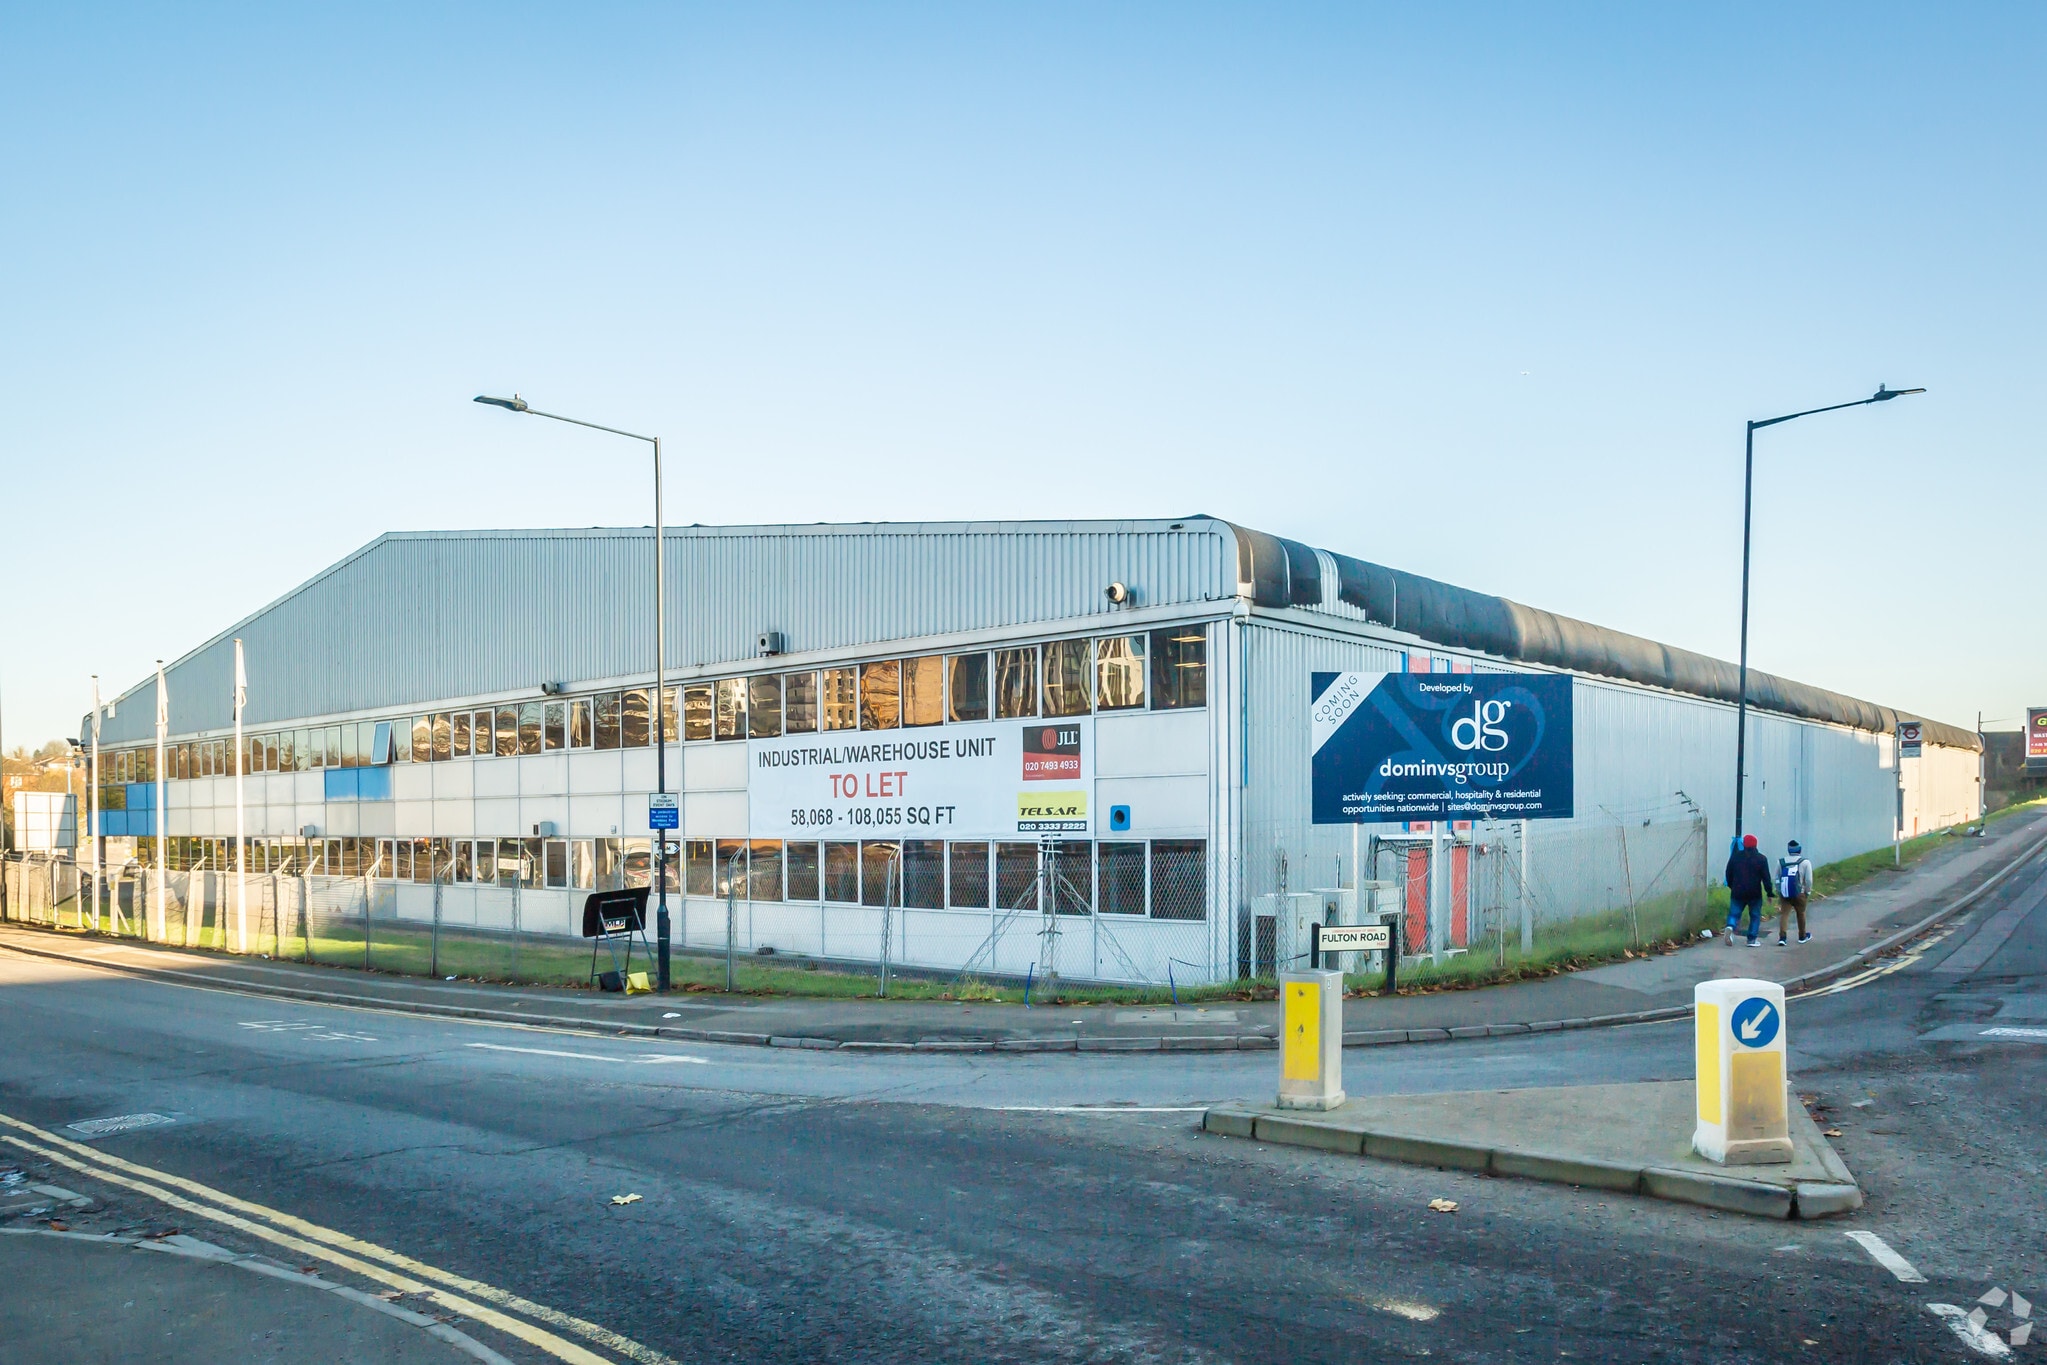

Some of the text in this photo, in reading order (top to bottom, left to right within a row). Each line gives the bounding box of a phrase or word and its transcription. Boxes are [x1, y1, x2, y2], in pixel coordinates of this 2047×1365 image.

[1419, 683, 1474, 694] Developed by
[1315, 675, 1358, 722] COMING
[1328, 690, 1359, 724] SOON
[1451, 699, 1512, 751] dg
[1057, 731, 1078, 746] JLL
[758, 737, 997, 768] INDUSTRIAL/WAREHOUSE UNIT
[1025, 760, 1079, 771] 020 7493 4933
[1379, 758, 1510, 785] dominvsgroup
[829, 771, 908, 799] TO LET
[1342, 788, 1542, 803] actively seeking: commercial, hospitality & residential
[1020, 806, 1078, 816] TELSAR
[1342, 803, 1396, 816] opportunities
[1396, 802, 1440, 812] nationwide
[1447, 801, 1543, 813] sites@dominvsgroup.com
[791, 808, 834, 829] 58,068
[847, 807, 902, 828] 108,055
[906, 806, 931, 826] SQ
[935, 805, 956, 824] FT
[1019, 822, 1086, 831] 020 3333 2222
[1321, 932, 1387, 943] FULTON ROAD
